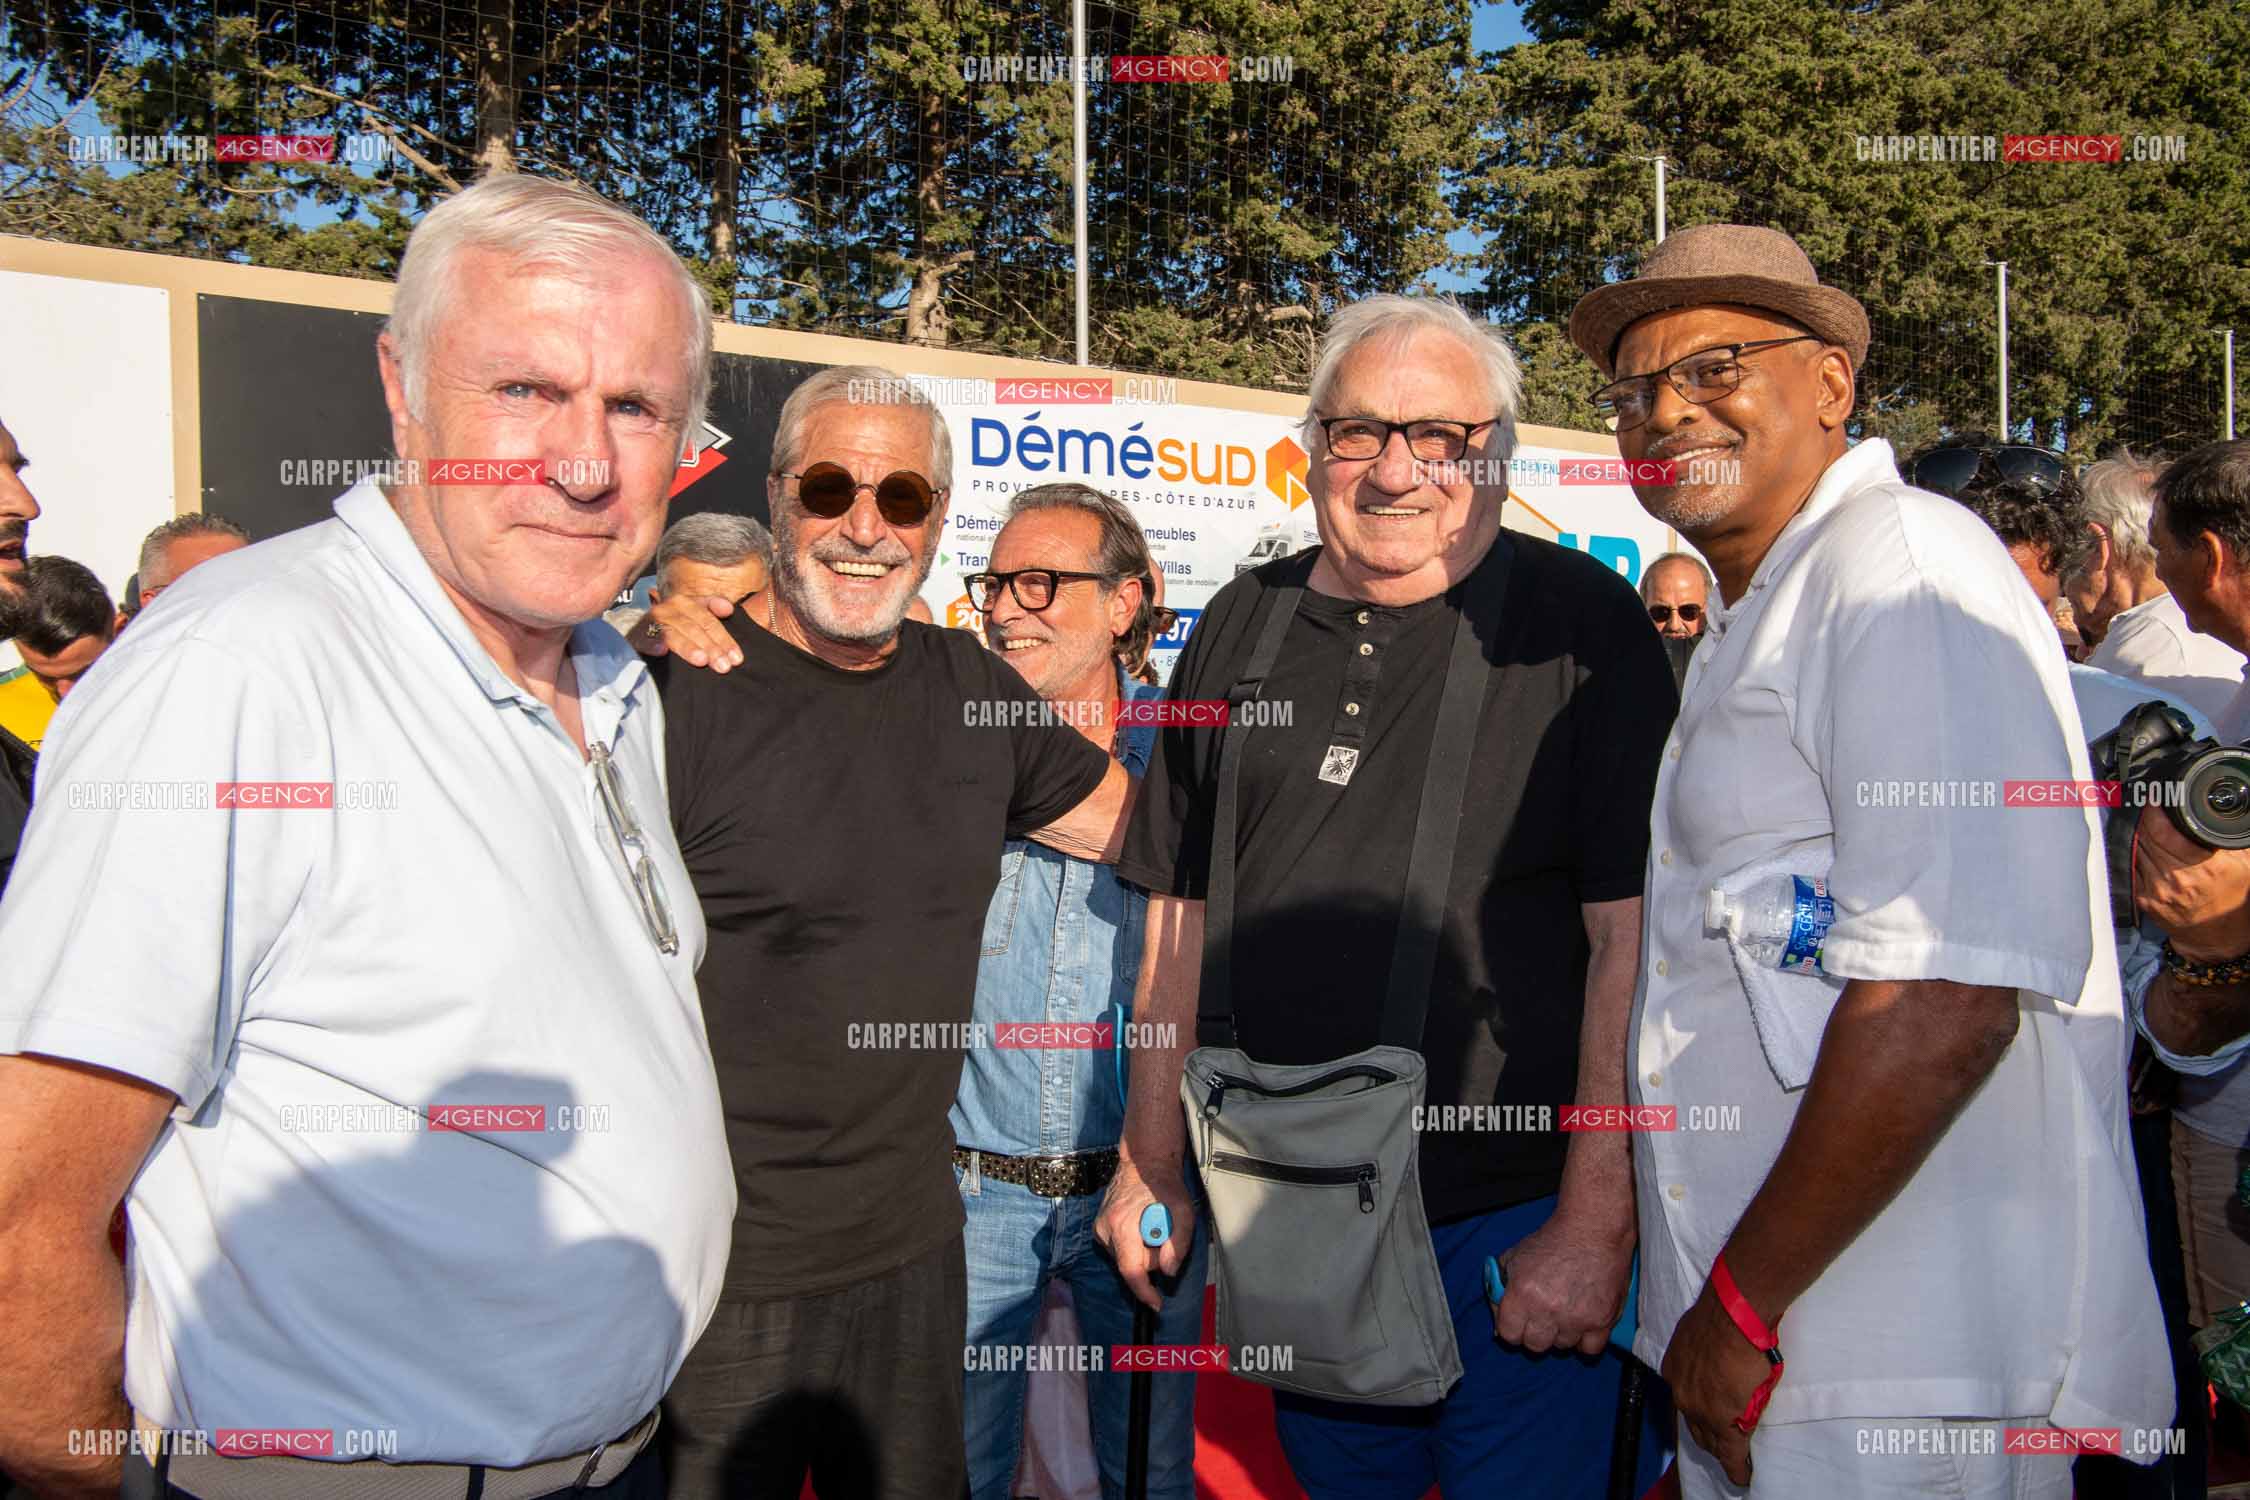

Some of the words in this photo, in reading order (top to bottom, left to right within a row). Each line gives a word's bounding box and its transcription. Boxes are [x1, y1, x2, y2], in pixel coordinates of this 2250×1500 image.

[1203, 496, 1256, 510] D'AZUR
[1144, 527, 1197, 542] meubles
[1160, 559, 1192, 575] Villas
